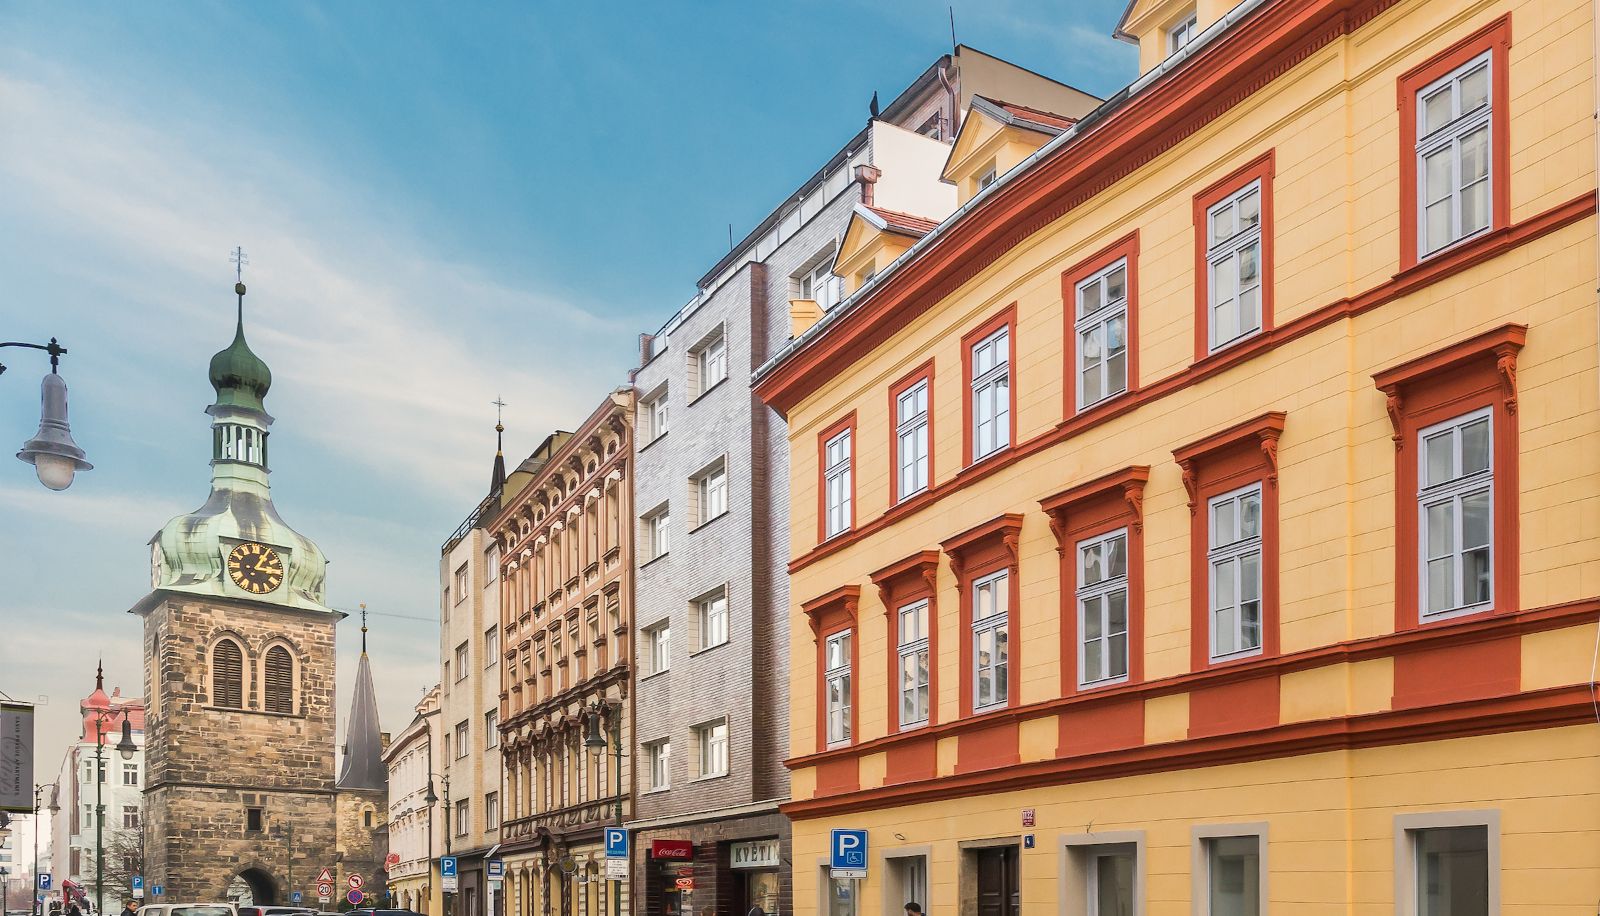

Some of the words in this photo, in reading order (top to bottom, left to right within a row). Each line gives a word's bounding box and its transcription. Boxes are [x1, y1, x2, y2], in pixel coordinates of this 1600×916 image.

[610, 831, 623, 849] P
[839, 834, 860, 857] P
[444, 860, 454, 871] P
[40, 875, 49, 886] P
[134, 877, 141, 886] P
[320, 886, 330, 894] 20
